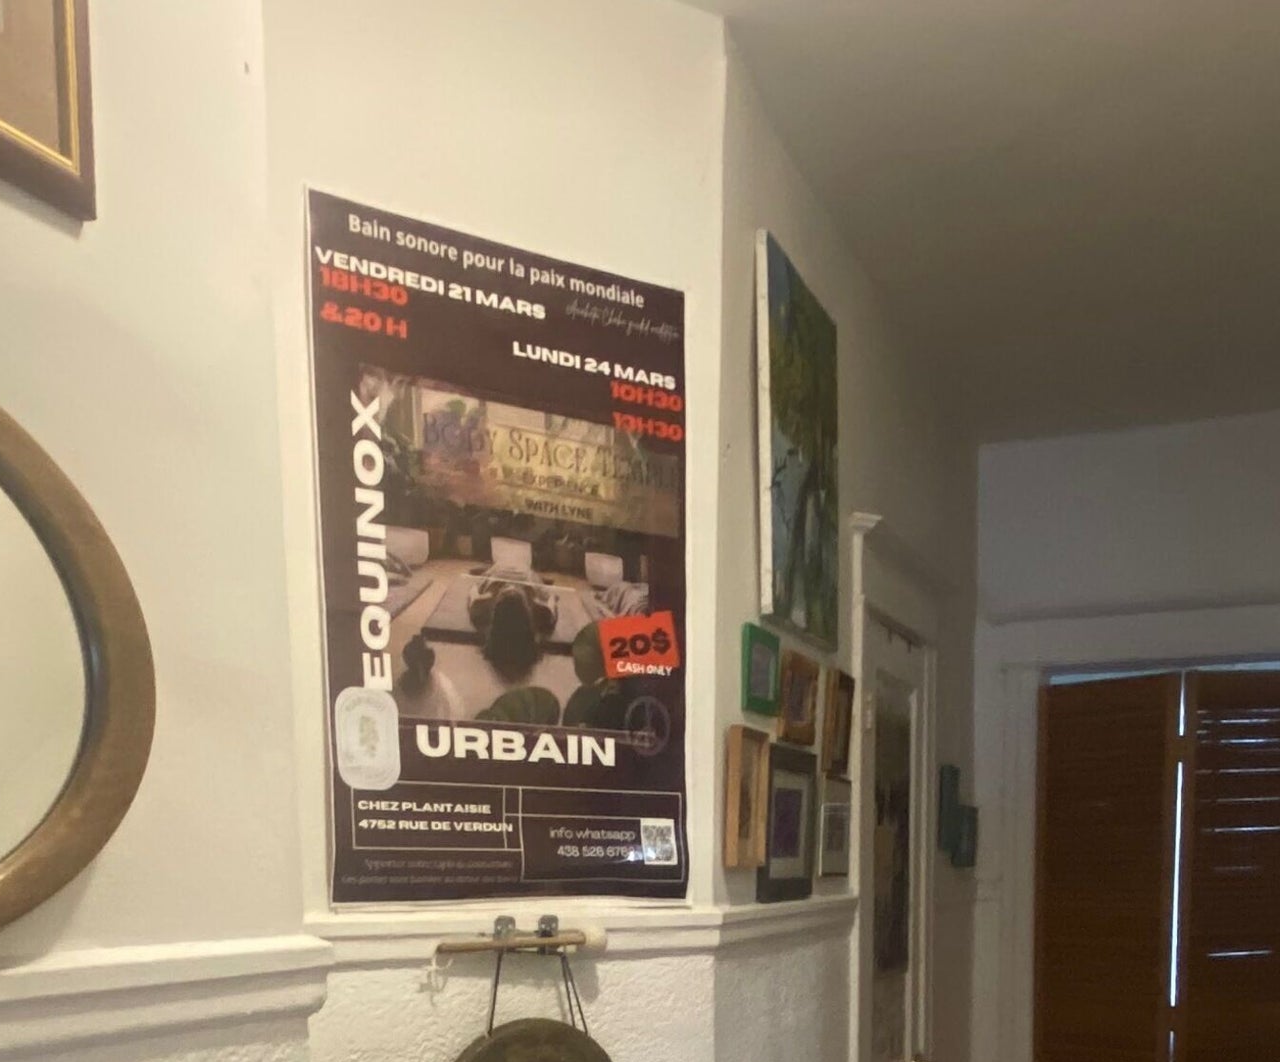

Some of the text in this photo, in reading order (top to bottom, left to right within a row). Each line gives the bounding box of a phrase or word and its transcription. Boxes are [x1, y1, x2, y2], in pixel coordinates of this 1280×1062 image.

[348, 213, 645, 309] Bain sonore pour la paix mondiale
[314, 246, 547, 320] VENDREDI 21 MARS
[512, 340, 676, 391] LUNDI 24 MARS
[610, 380, 684, 413] 10H30
[508, 427, 588, 473] SPACE
[350, 389, 394, 693] EQUINOX
[609, 627, 672, 660] 20$
[616, 661, 673, 677] CASH ONLY
[415, 723, 616, 767] URBAIN
[357, 800, 492, 815] CHEZ PLANTAISIE
[398, 819, 429, 831] RUE
[431, 820, 452, 832] DE
[453, 821, 514, 833] VERDUN
[549, 826, 637, 843] info whatsapp
